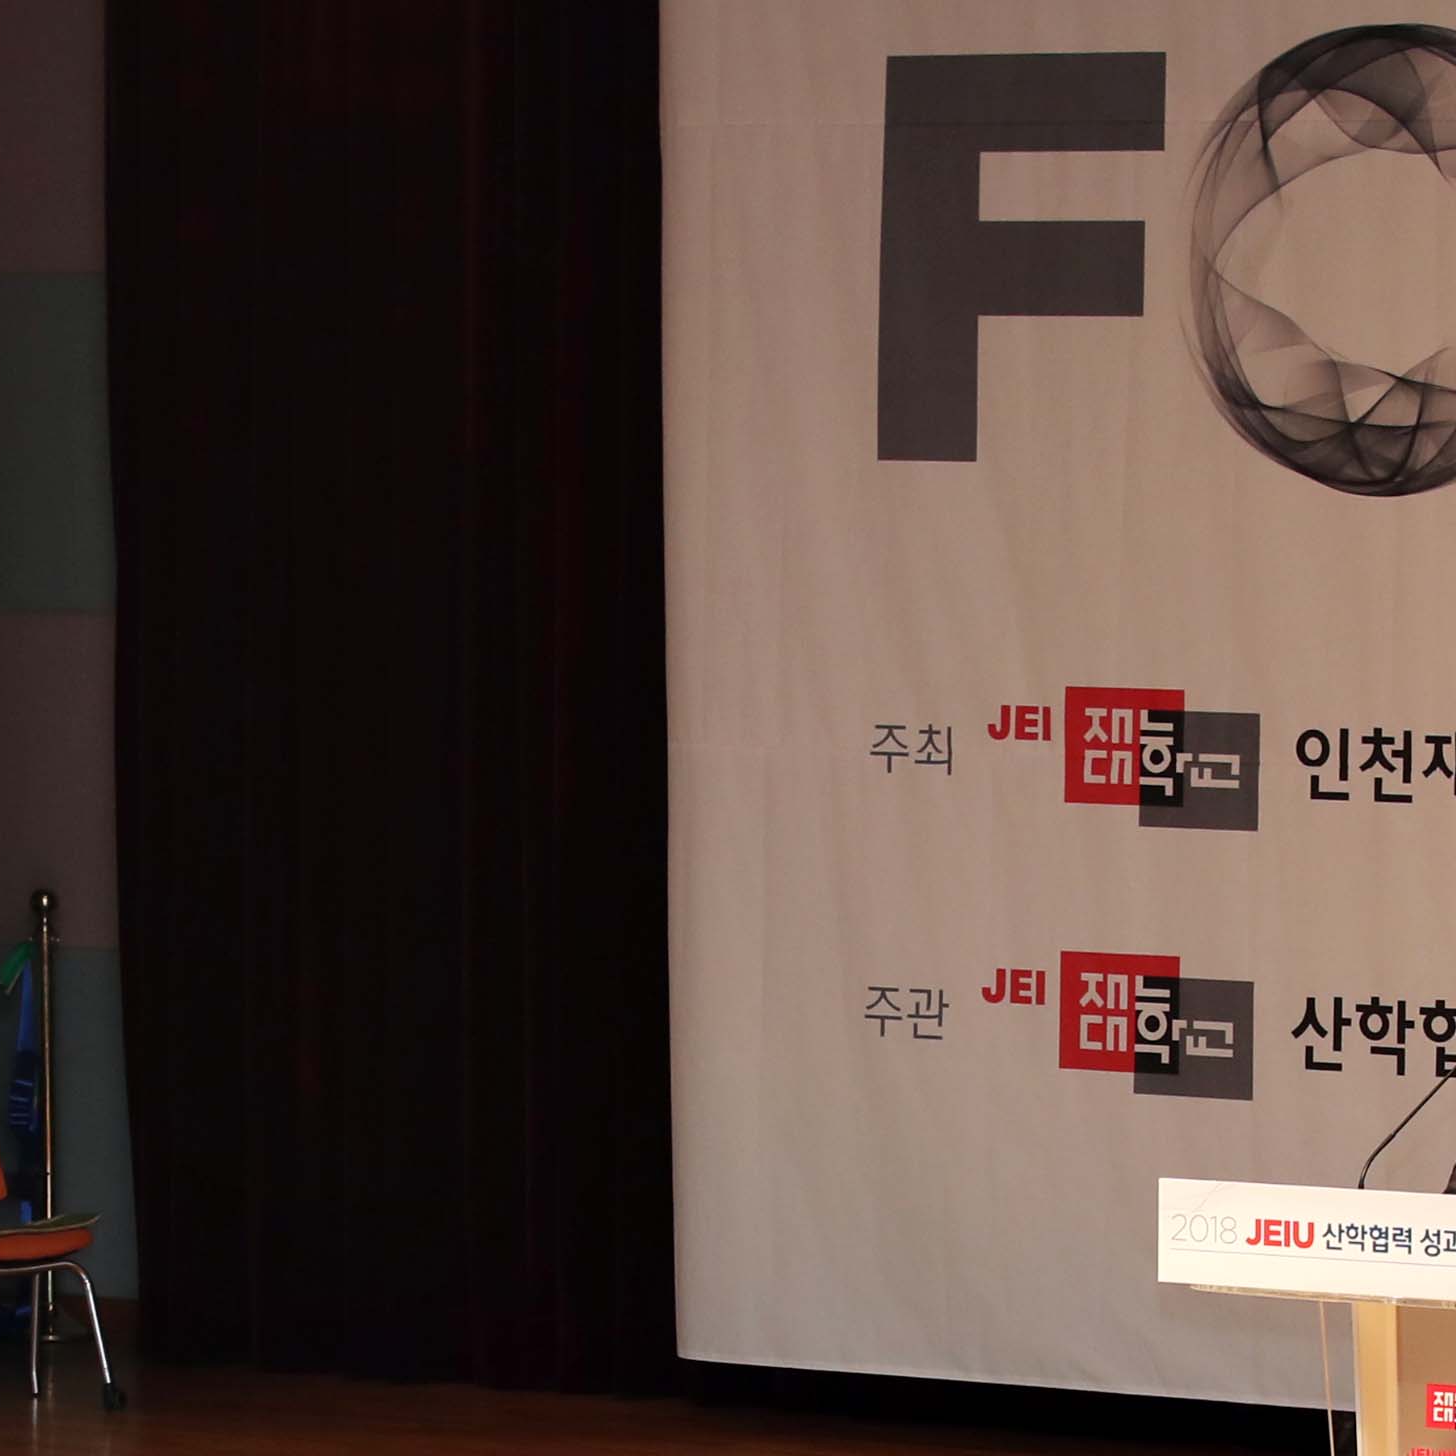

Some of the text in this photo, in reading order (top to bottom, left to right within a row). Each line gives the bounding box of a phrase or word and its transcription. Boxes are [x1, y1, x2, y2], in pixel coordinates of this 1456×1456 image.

[987, 705, 1052, 741] JEI
[870, 723, 953, 776] 주최
[981, 968, 1047, 1005] JEI
[864, 986, 950, 1040] 주관
[1171, 1213, 1237, 1244] 2018
[1246, 1219, 1314, 1248] JEIU
[1322, 1223, 1412, 1254] 산학협력
